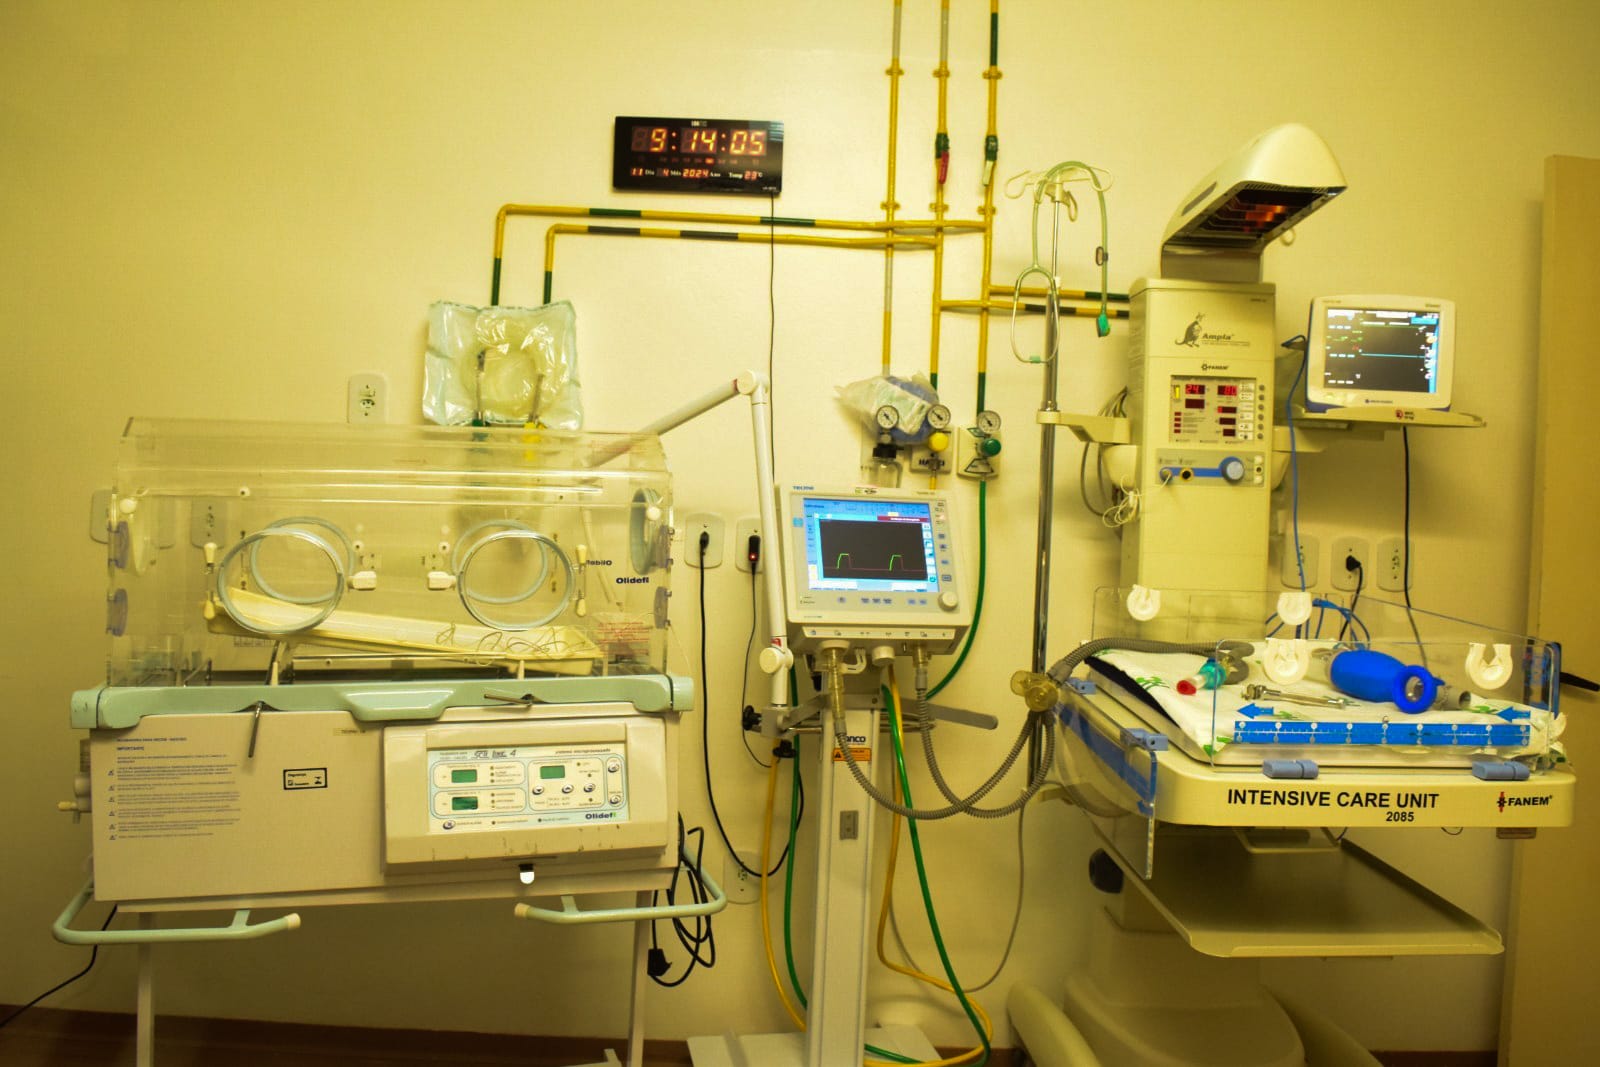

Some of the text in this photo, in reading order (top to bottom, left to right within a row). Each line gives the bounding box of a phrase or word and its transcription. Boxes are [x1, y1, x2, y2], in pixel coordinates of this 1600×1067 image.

[631, 168, 643, 176] 11
[682, 168, 709, 178] 2024
[1202, 333, 1231, 341] Ampla
[1227, 789, 1439, 808] INTENSIVE CARE UNIT
[1385, 811, 1415, 822] 2085
